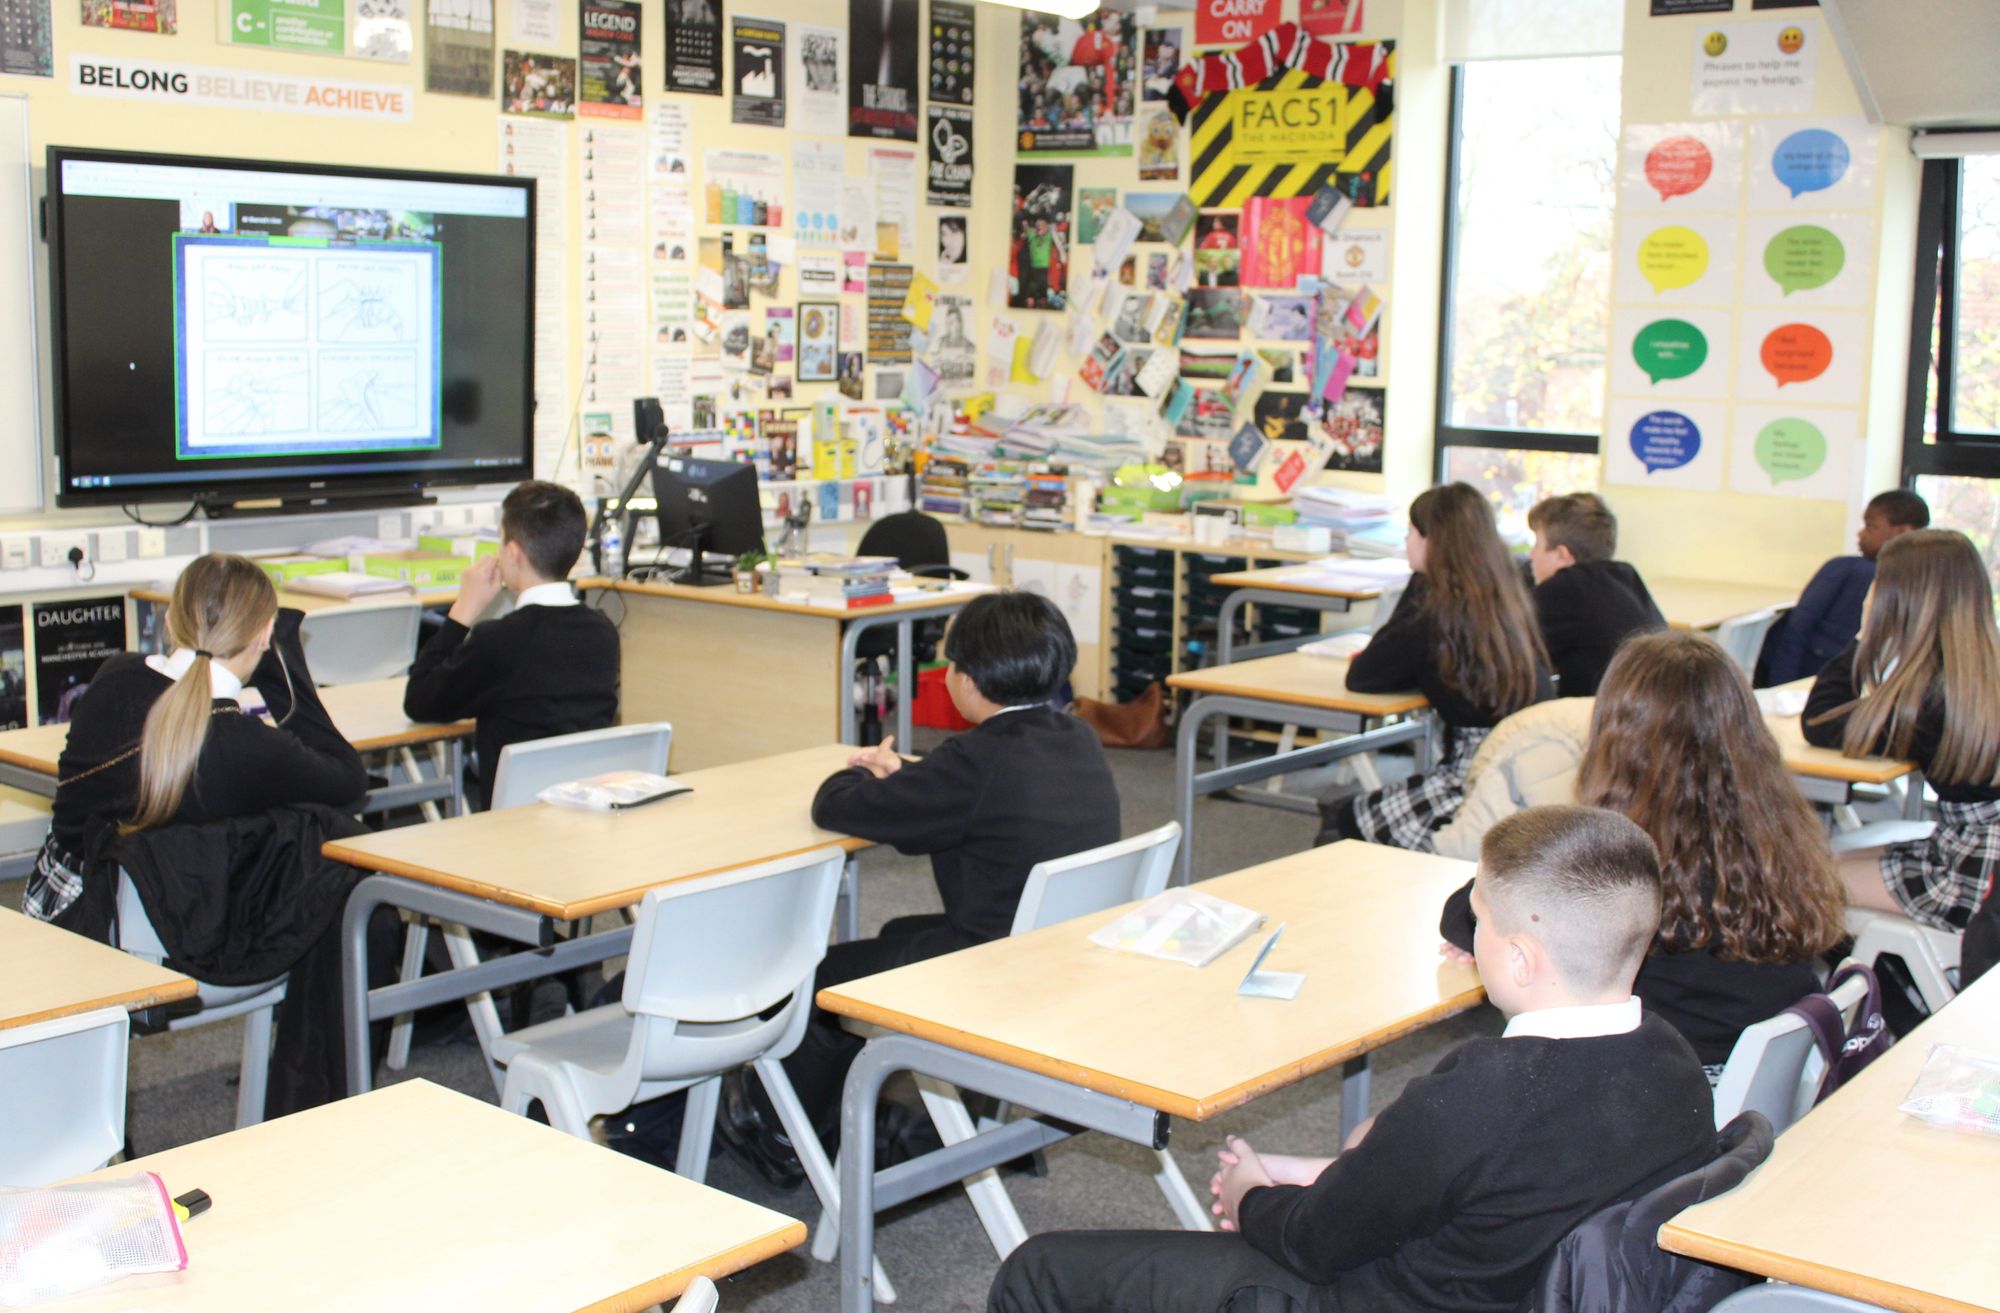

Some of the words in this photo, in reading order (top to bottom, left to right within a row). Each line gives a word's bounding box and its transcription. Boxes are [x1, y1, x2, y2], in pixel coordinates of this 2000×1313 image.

[1211, 0, 1266, 17] CARRY
[584, 12, 636, 32] LEGEND
[1222, 20, 1252, 38] ON
[79, 64, 188, 94] BELONG
[196, 74, 298, 105] BELIEVE
[304, 86, 404, 113] ACHIEVE
[1242, 97, 1338, 128] FAC51
[39, 605, 121, 628] DAUGHTER
